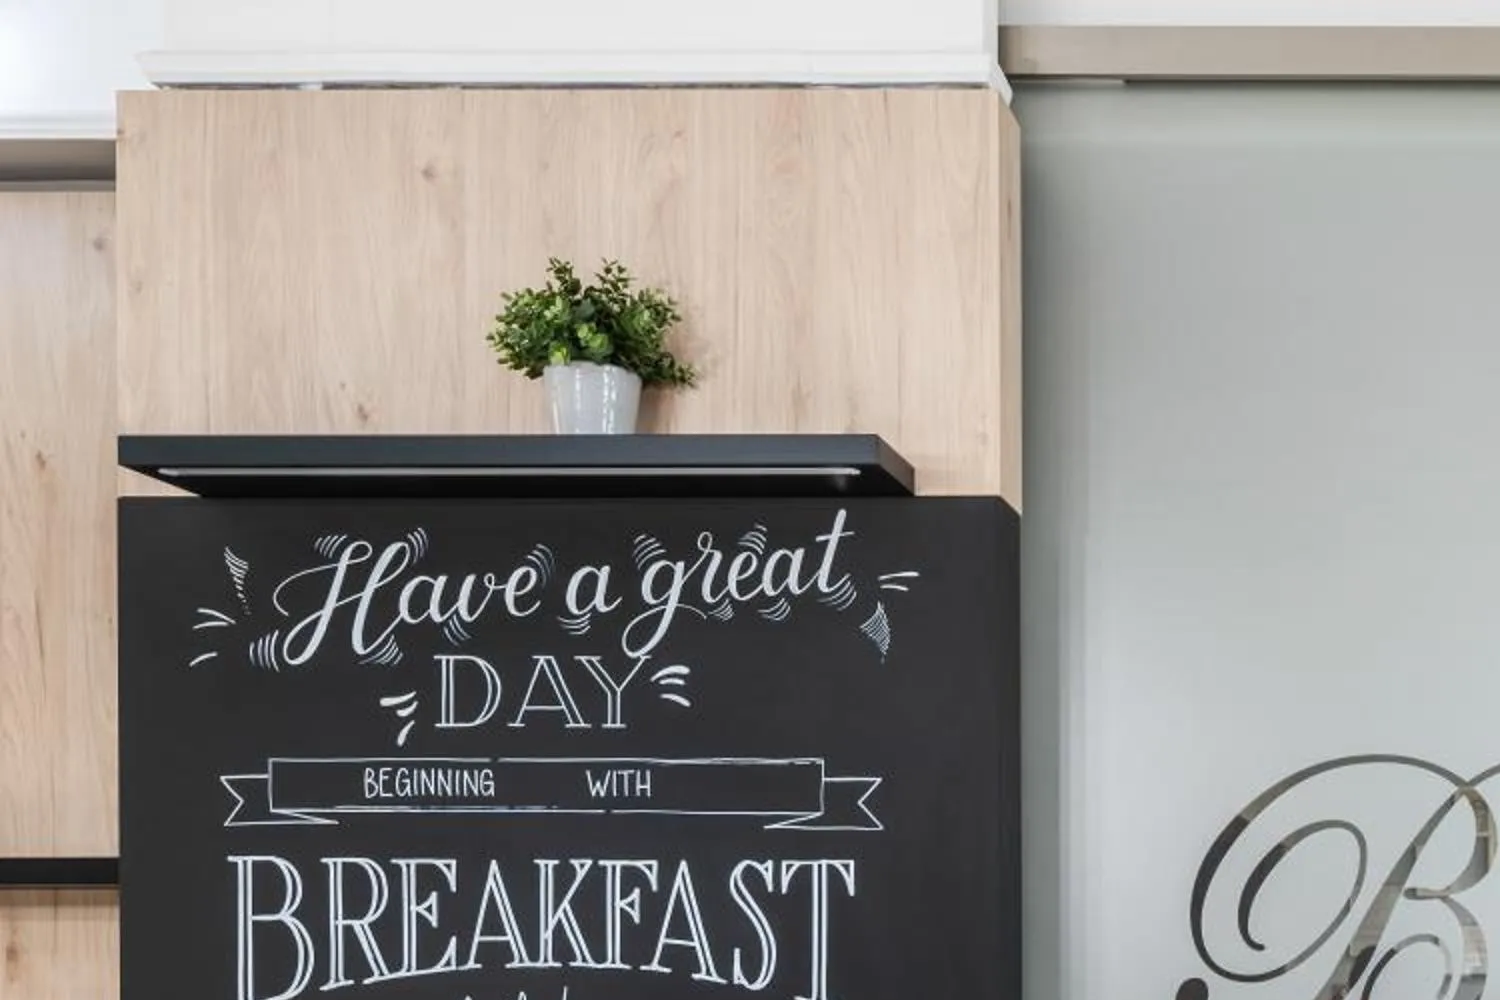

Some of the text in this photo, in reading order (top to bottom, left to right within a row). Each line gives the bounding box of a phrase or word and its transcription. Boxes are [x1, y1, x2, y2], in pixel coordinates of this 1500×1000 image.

[274, 509, 855, 665] Have a great
[433, 654, 651, 729] DAY
[362, 766, 652, 798] BEGINNING WITH
